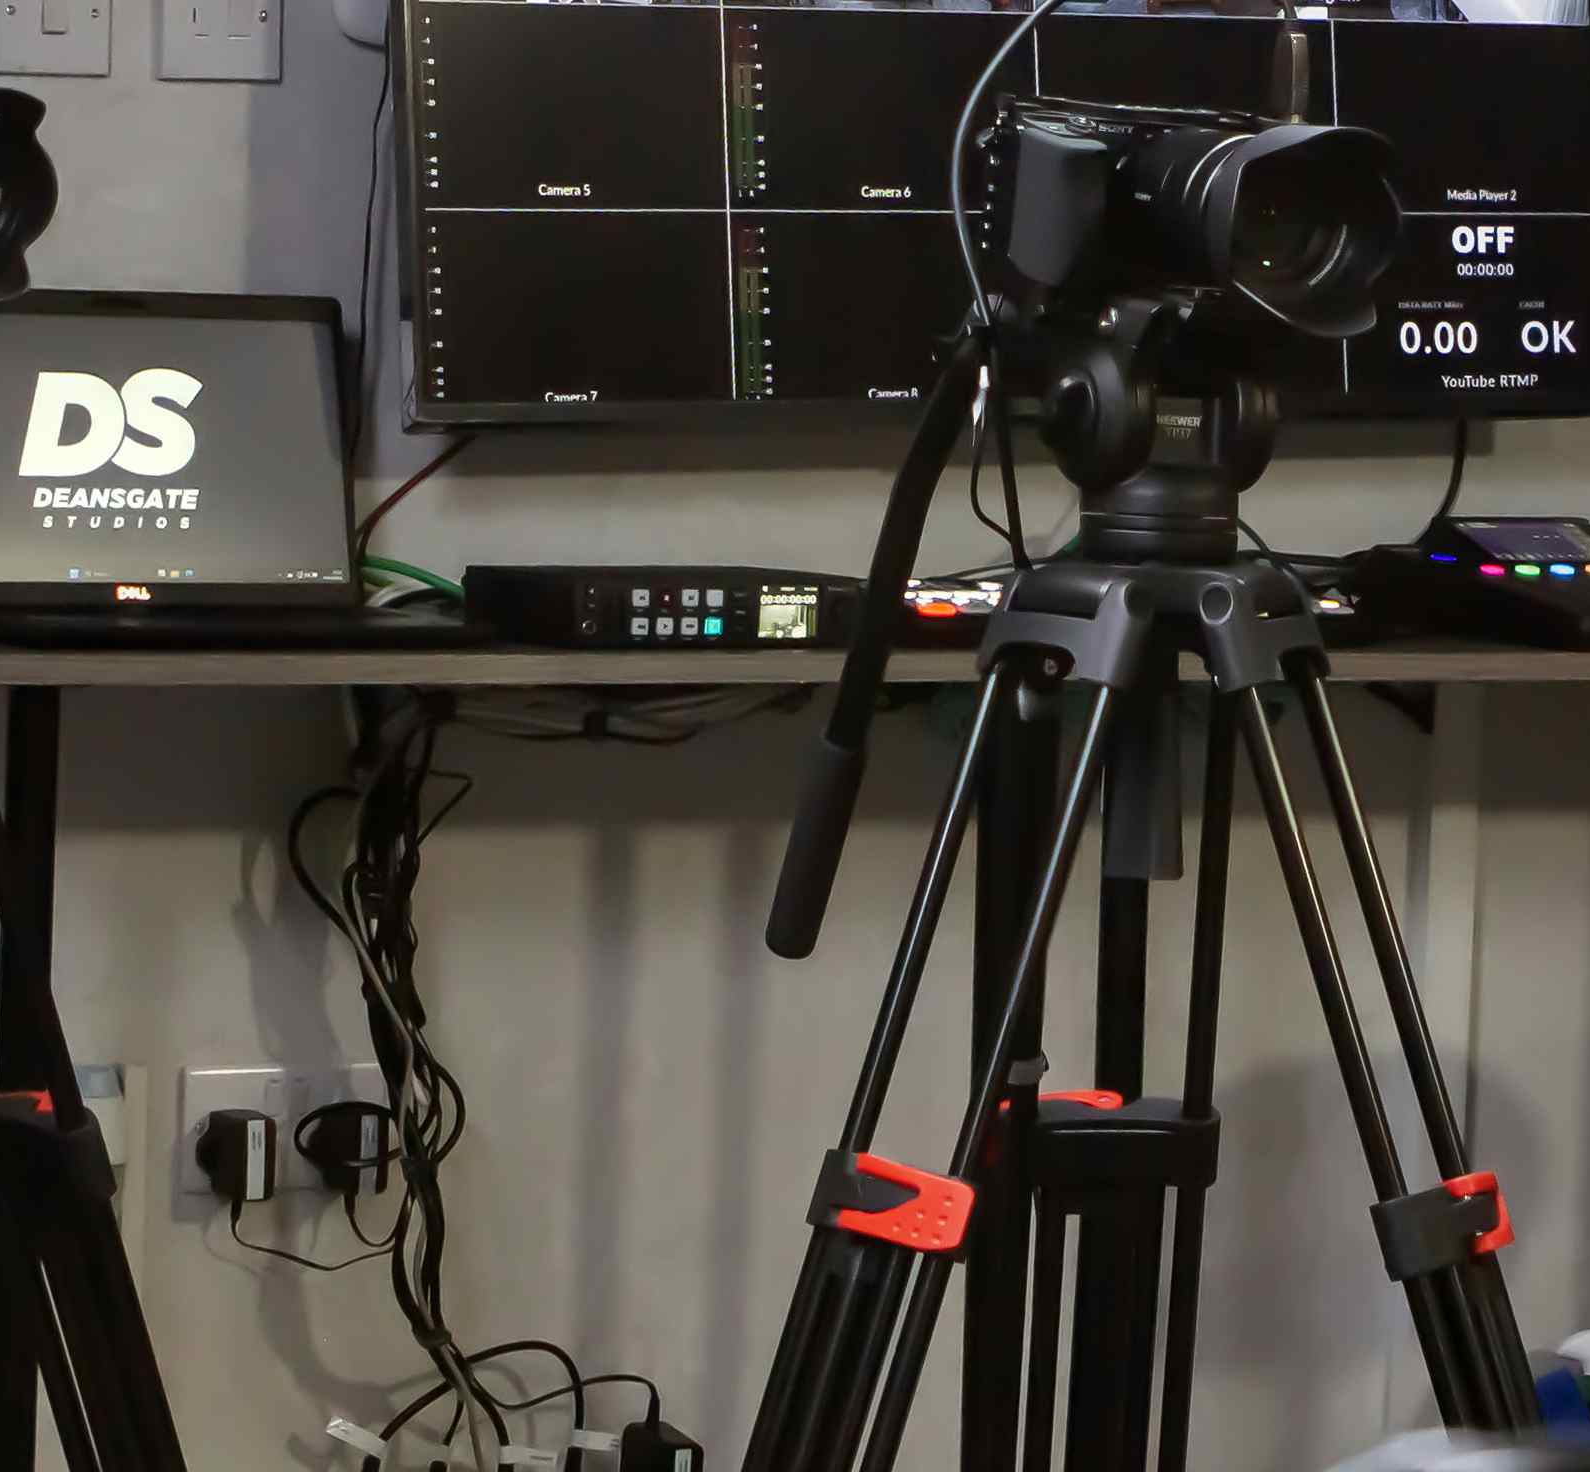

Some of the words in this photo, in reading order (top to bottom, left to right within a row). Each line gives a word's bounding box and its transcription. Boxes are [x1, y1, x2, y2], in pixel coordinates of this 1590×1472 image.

[538, 184, 581, 196] Camera
[583, 184, 591, 196] 5
[861, 186, 902, 198] Camera
[903, 186, 911, 198] 6
[1447, 189, 1477, 201] Media
[1479, 189, 1508, 203] Player
[1510, 190, 1517, 201] 2
[1452, 226, 1515, 254] OFF
[1457, 263, 1514, 276] 00:00:00
[1400, 321, 1478, 354] 0.00
[1521, 320, 1577, 353] OK
[1441, 375, 1495, 388] YouTube
[1500, 374, 1539, 388] RTMP
[545, 391, 587, 403] Camera
[590, 390, 598, 401] 7
[868, 388, 909, 399] Camera
[18, 367, 203, 477] DS
[33, 487, 199, 510] DEANSGATE
[42, 515, 191, 530] STUDIOS
